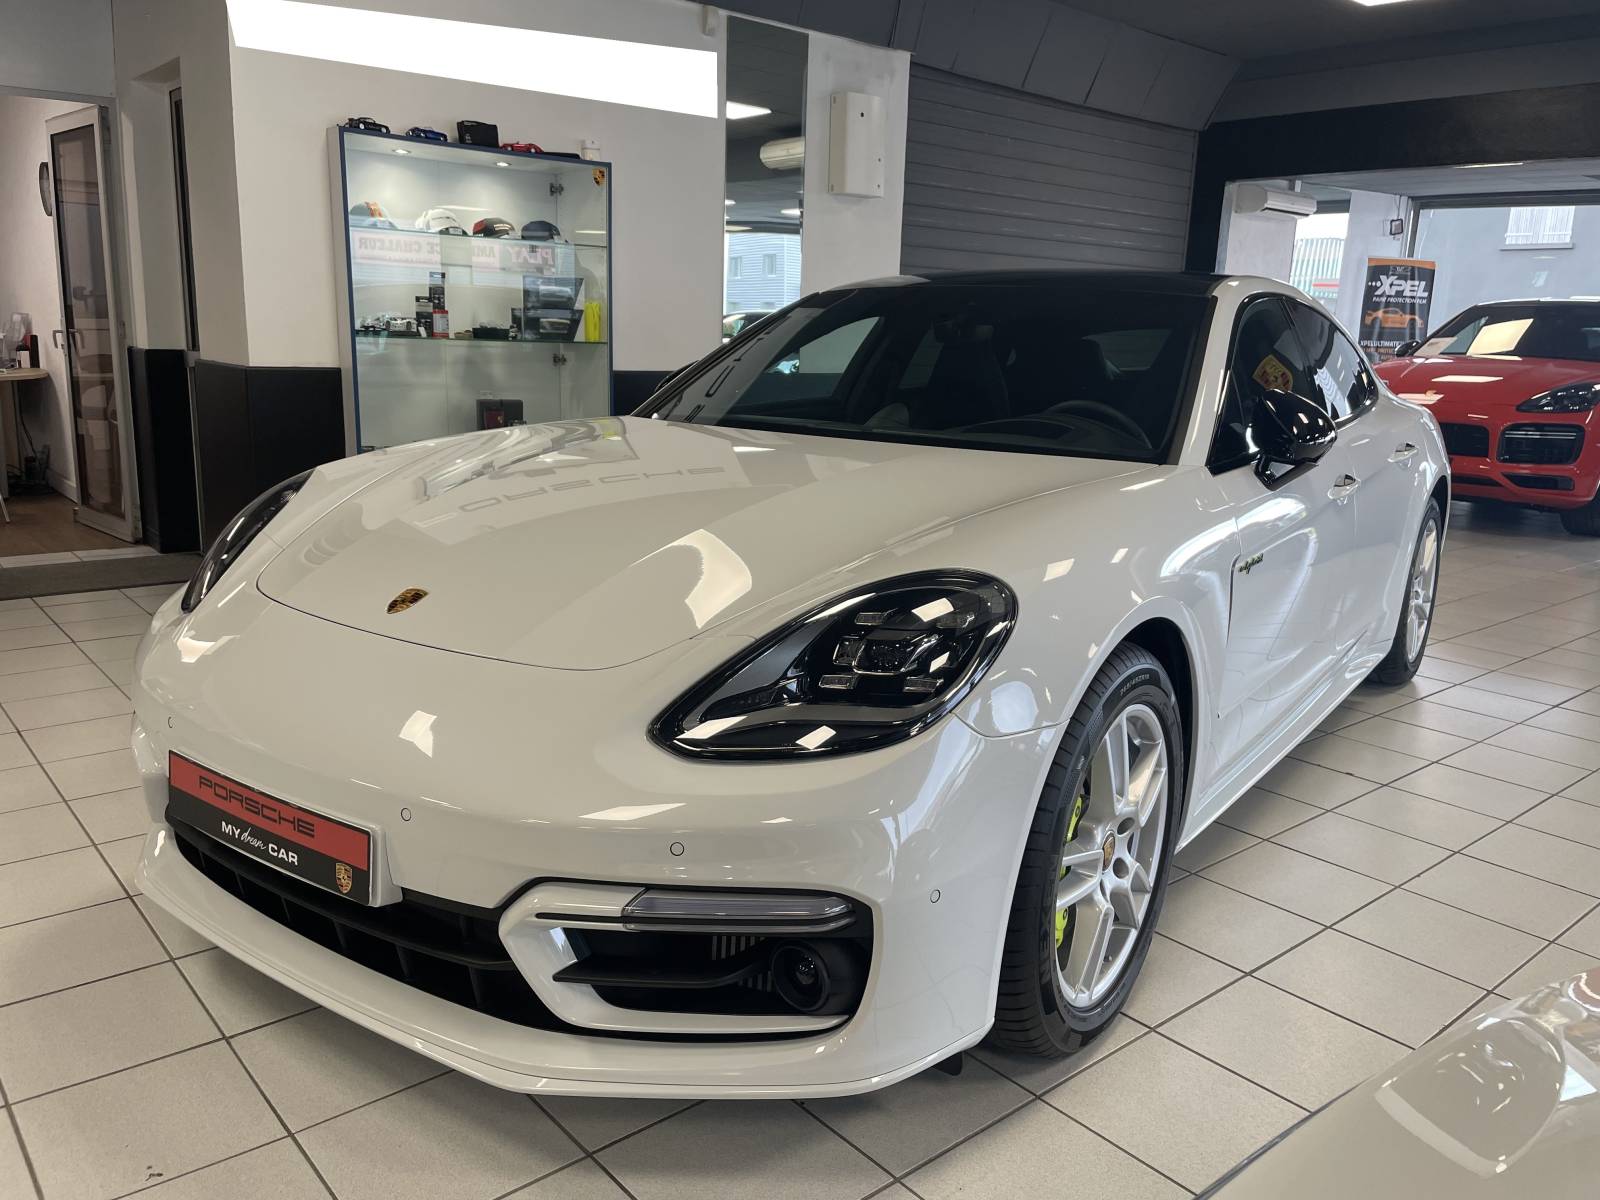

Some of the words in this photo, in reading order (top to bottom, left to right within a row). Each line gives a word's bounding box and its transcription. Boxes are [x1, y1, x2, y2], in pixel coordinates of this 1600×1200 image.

[1374, 274, 1428, 297] XPEL
[198, 775, 315, 839] PORSCHE
[221, 820, 241, 840] MY
[239, 826, 267, 851] dream
[268, 842, 300, 866] CAR
